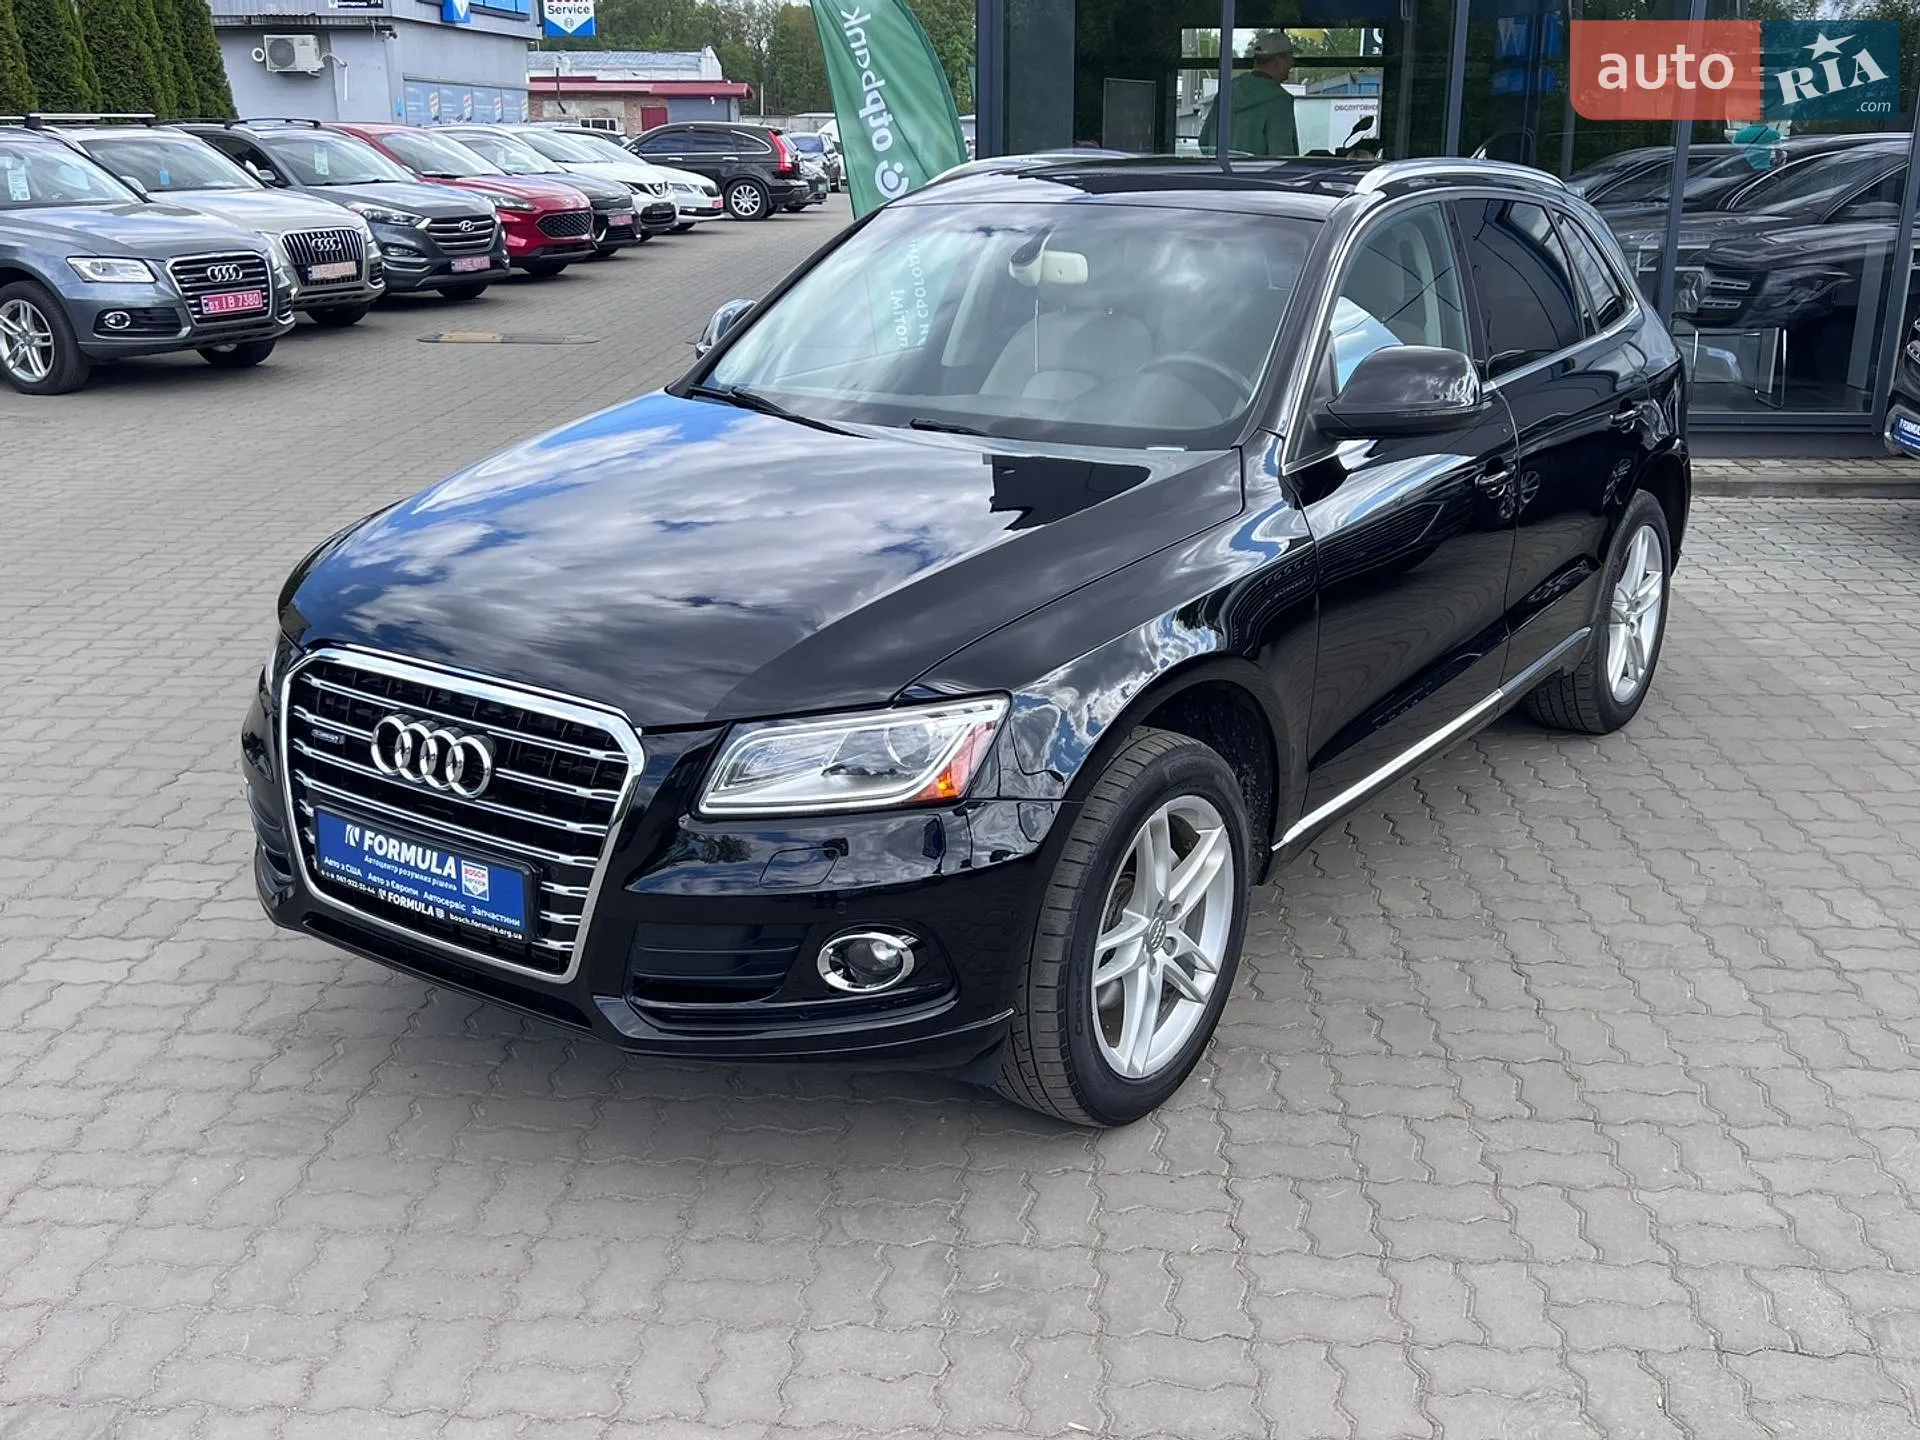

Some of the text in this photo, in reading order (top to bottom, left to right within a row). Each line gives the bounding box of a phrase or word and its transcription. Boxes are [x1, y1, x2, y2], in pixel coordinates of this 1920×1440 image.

[547, 4, 591, 15] Service
[363, 829, 457, 880] FORMULA
[367, 872, 385, 886] Авто
[422, 891, 467, 912] Автосервіс
[470, 905, 521, 927] Запчастини
[387, 891, 435, 917] FORMULA
